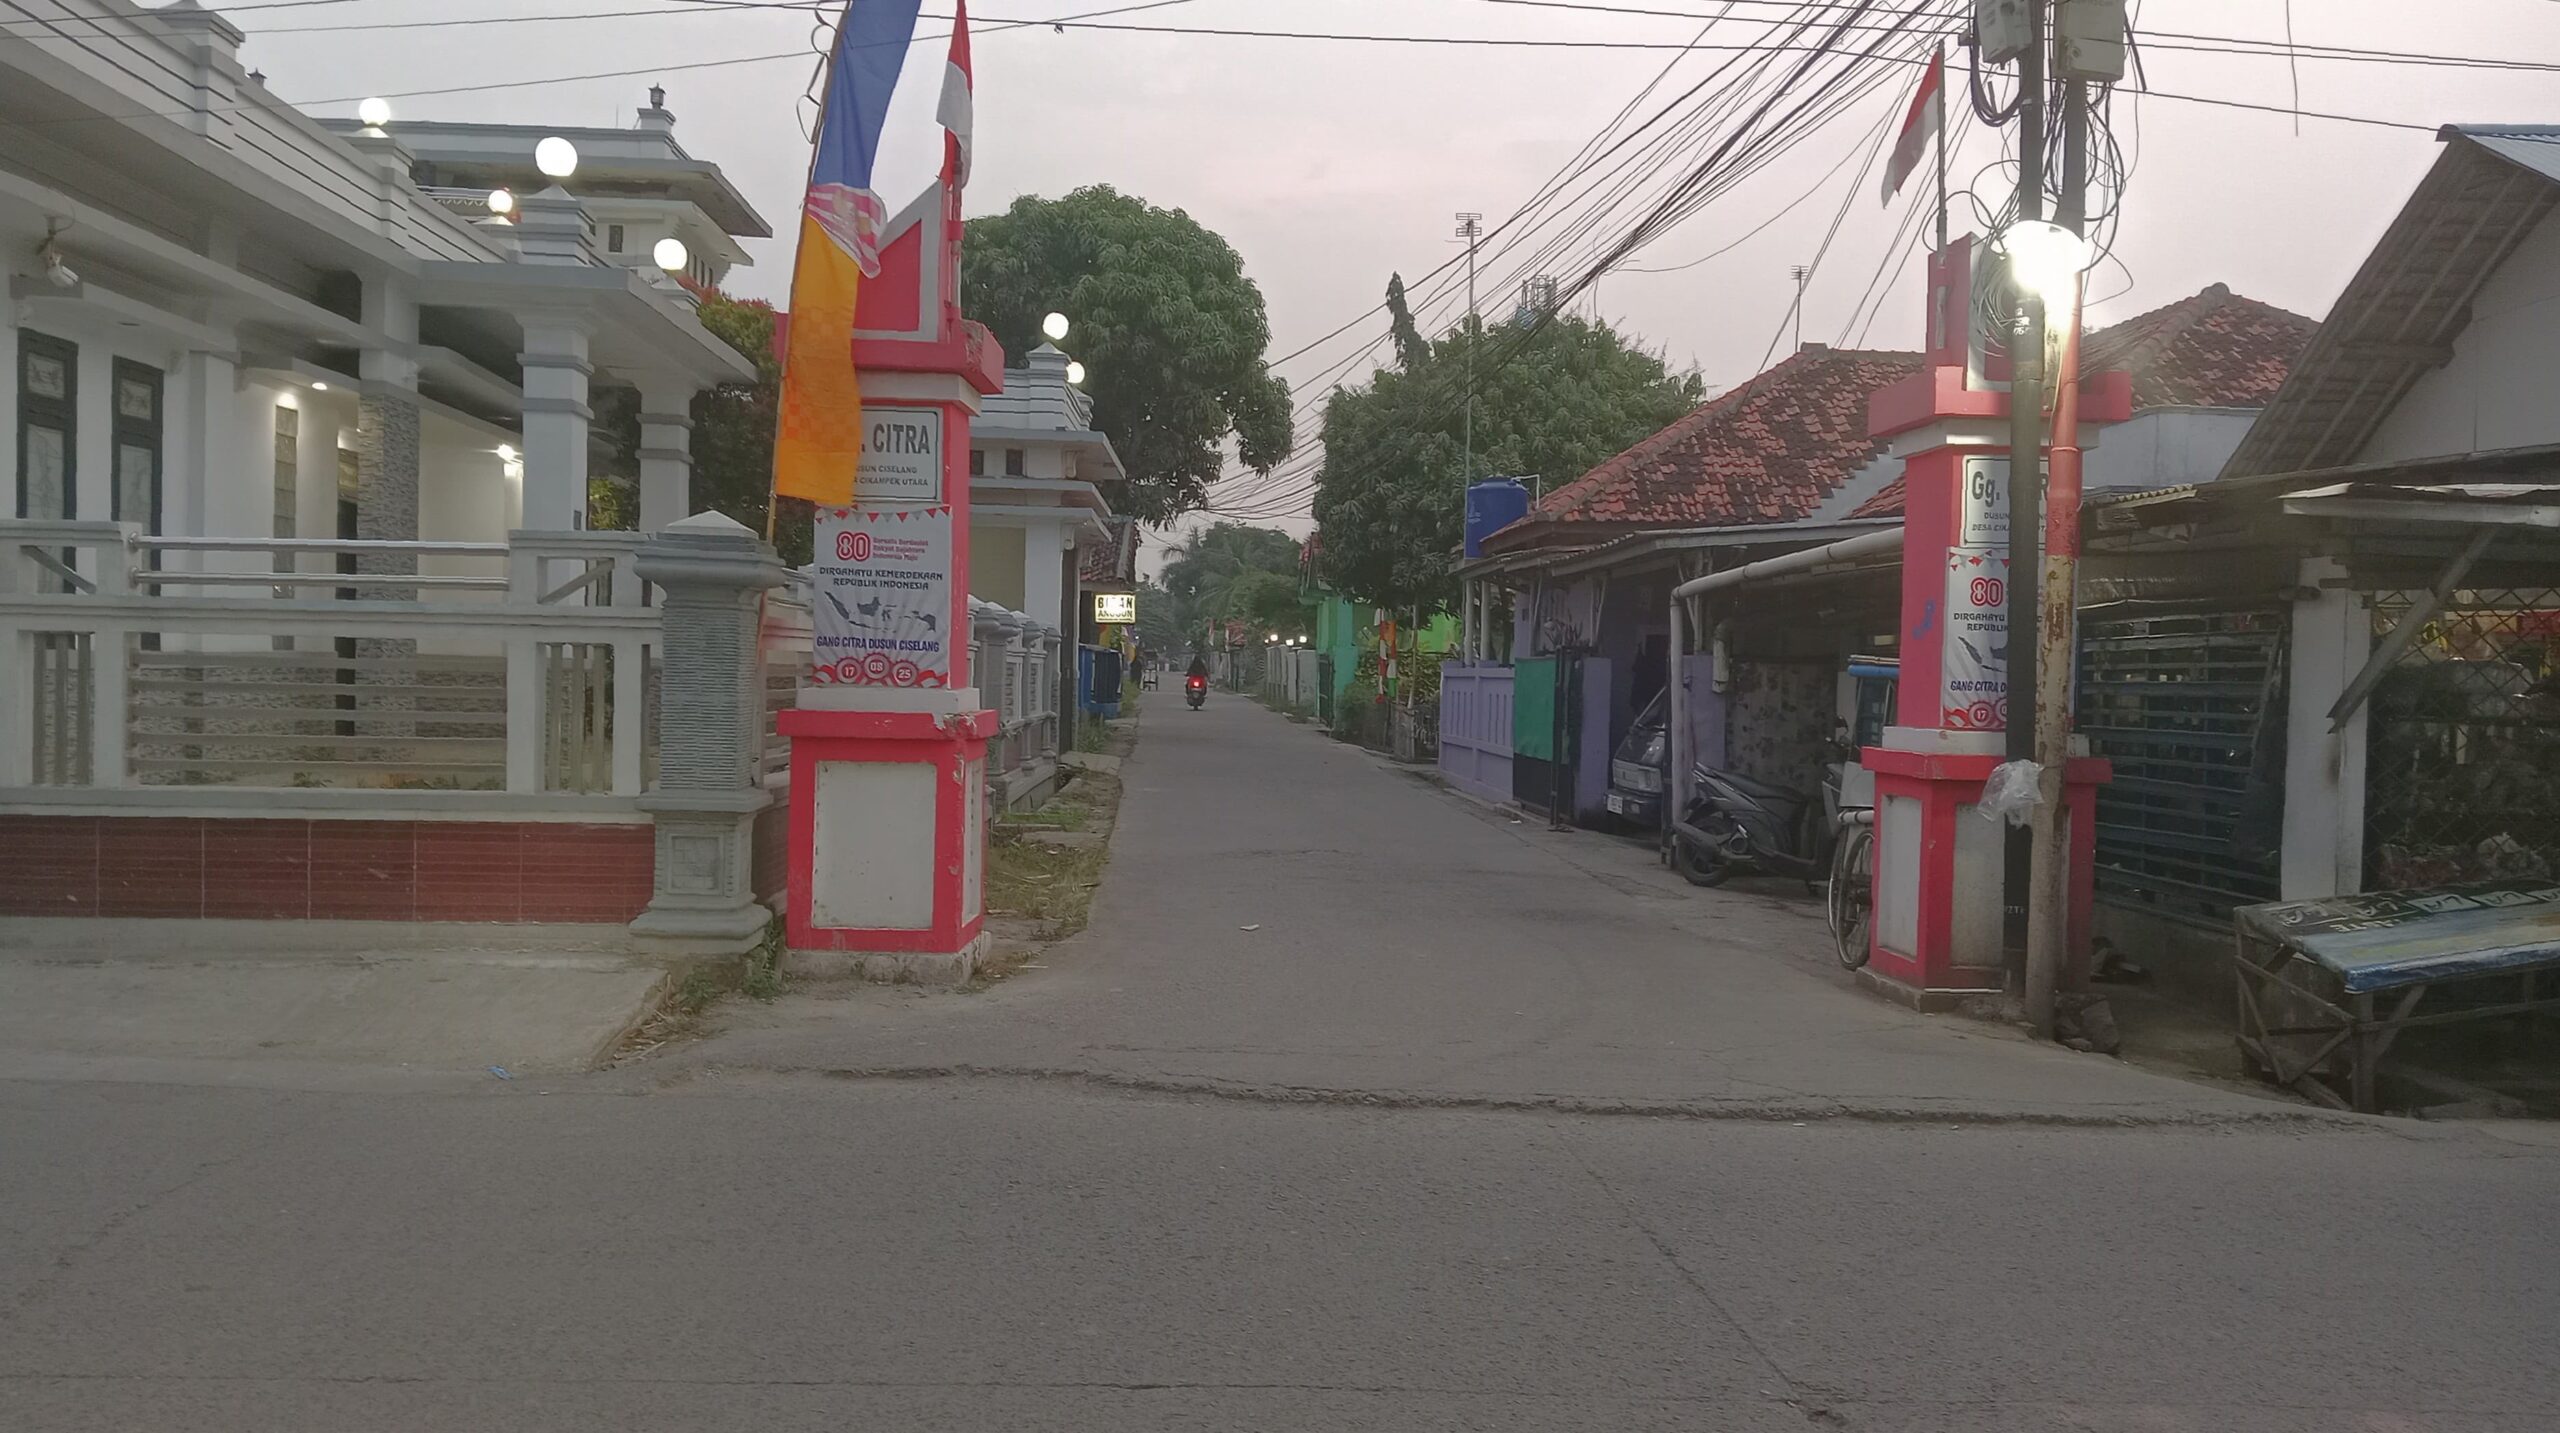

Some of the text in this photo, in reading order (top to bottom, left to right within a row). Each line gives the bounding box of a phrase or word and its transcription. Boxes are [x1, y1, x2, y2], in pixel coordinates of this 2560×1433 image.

[873, 424, 930, 454] CITRA
[902, 478, 929, 487] UTARA
[1972, 471, 2000, 508] Gg.
[836, 531, 871, 562] 80
[819, 567, 943, 581] DIRGAHAYU KEMERDEKAAN
[833, 578, 929, 590] REPUBLIK INDONESIA
[1970, 577, 2004, 608] 80
[1954, 612, 2005, 622] DIRGAHAYU
[816, 636, 940, 653] GANG CITRA DUSUN CISELANG
[844, 662, 911, 679] 17 08 25
[1950, 681, 1973, 692] GANG
[1974, 681, 1999, 693] CITRA
[1976, 710, 1987, 719] 17
